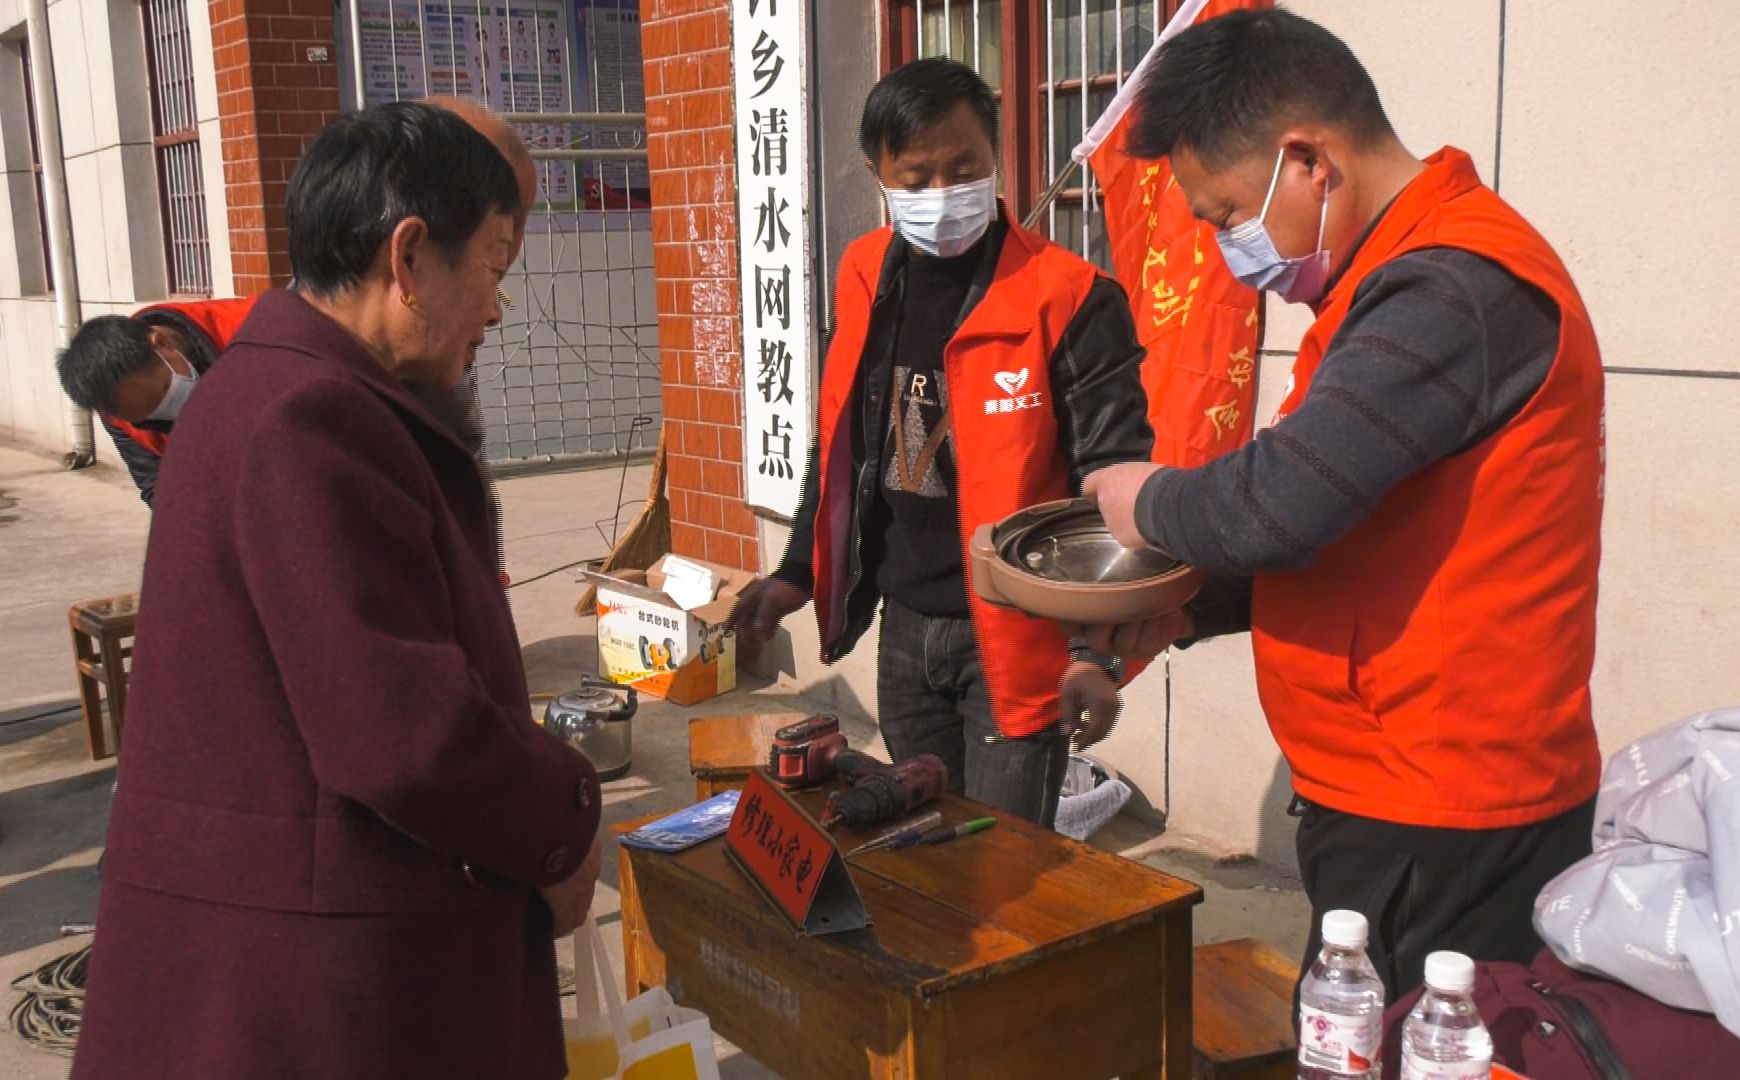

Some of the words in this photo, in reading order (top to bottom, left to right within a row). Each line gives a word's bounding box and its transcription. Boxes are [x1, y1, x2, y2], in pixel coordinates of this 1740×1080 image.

[911, 373, 928, 397] R
[638, 610, 680, 631] 台式砂轮机
[742, 791, 813, 894] 修理小家电
